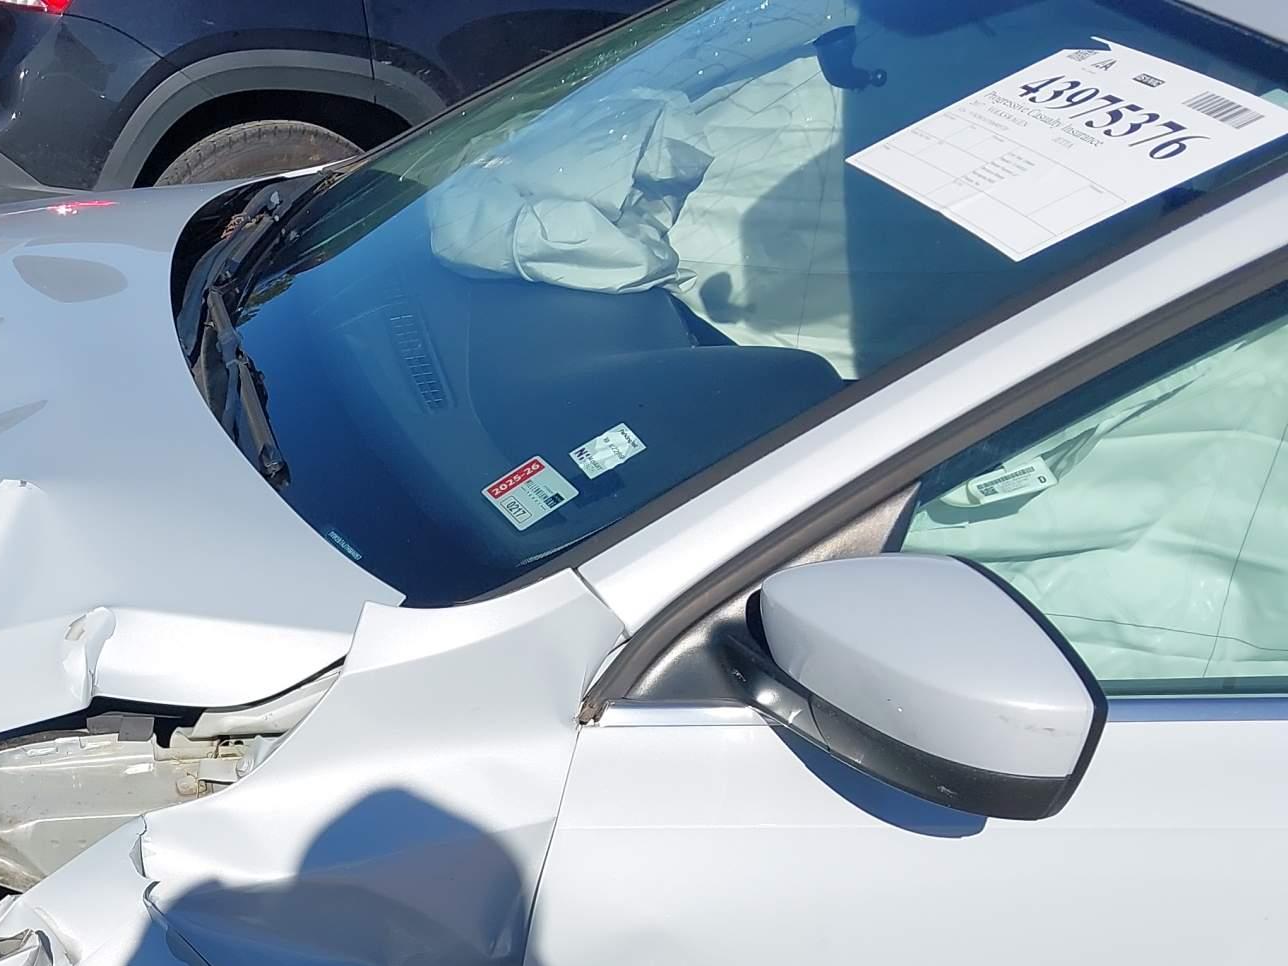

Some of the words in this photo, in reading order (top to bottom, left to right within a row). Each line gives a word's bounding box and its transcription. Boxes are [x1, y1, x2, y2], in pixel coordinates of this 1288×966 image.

[984, 90, 1030, 113] Progressive
[1029, 108, 1062, 128] Casualty
[1062, 123, 1104, 147] Insurance
[1018, 75, 1211, 159] 43975376
[491, 462, 540, 496] 2025-26
[506, 501, 527, 518] 0217
